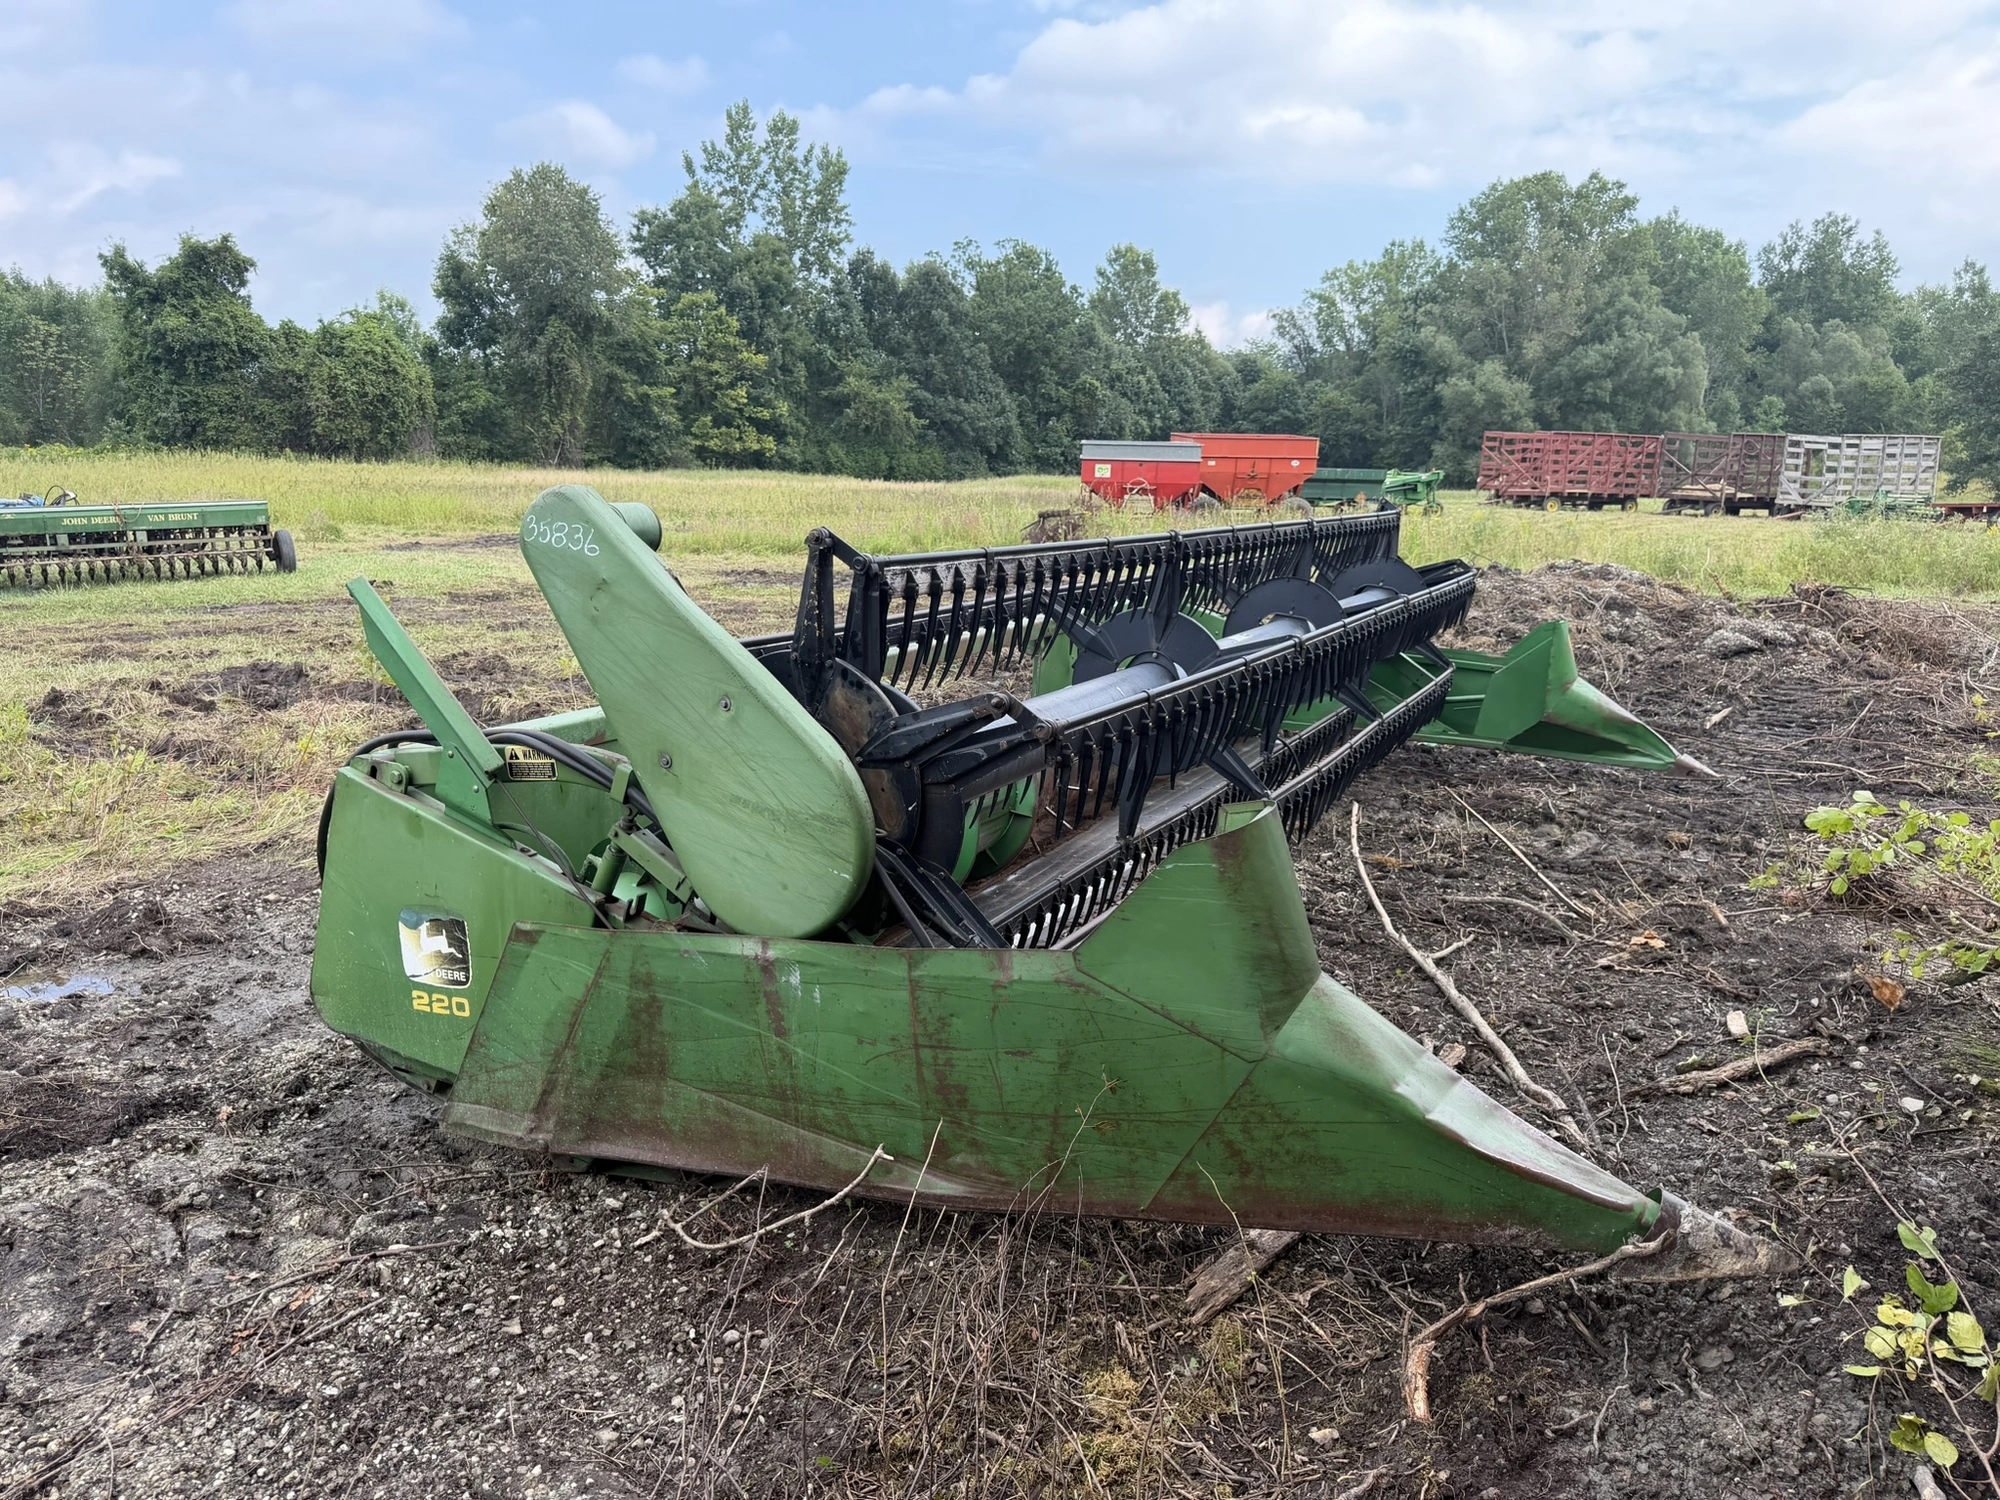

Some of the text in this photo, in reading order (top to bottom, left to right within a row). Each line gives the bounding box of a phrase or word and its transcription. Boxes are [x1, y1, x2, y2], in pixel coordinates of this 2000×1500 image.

[61, 517, 88, 525] JOHN
[147, 514, 165, 522] VAN
[168, 512, 199, 521] BRUNT
[523, 515, 600, 556] 35836
[435, 968, 467, 982] DEERE
[412, 990, 471, 1017] 220
